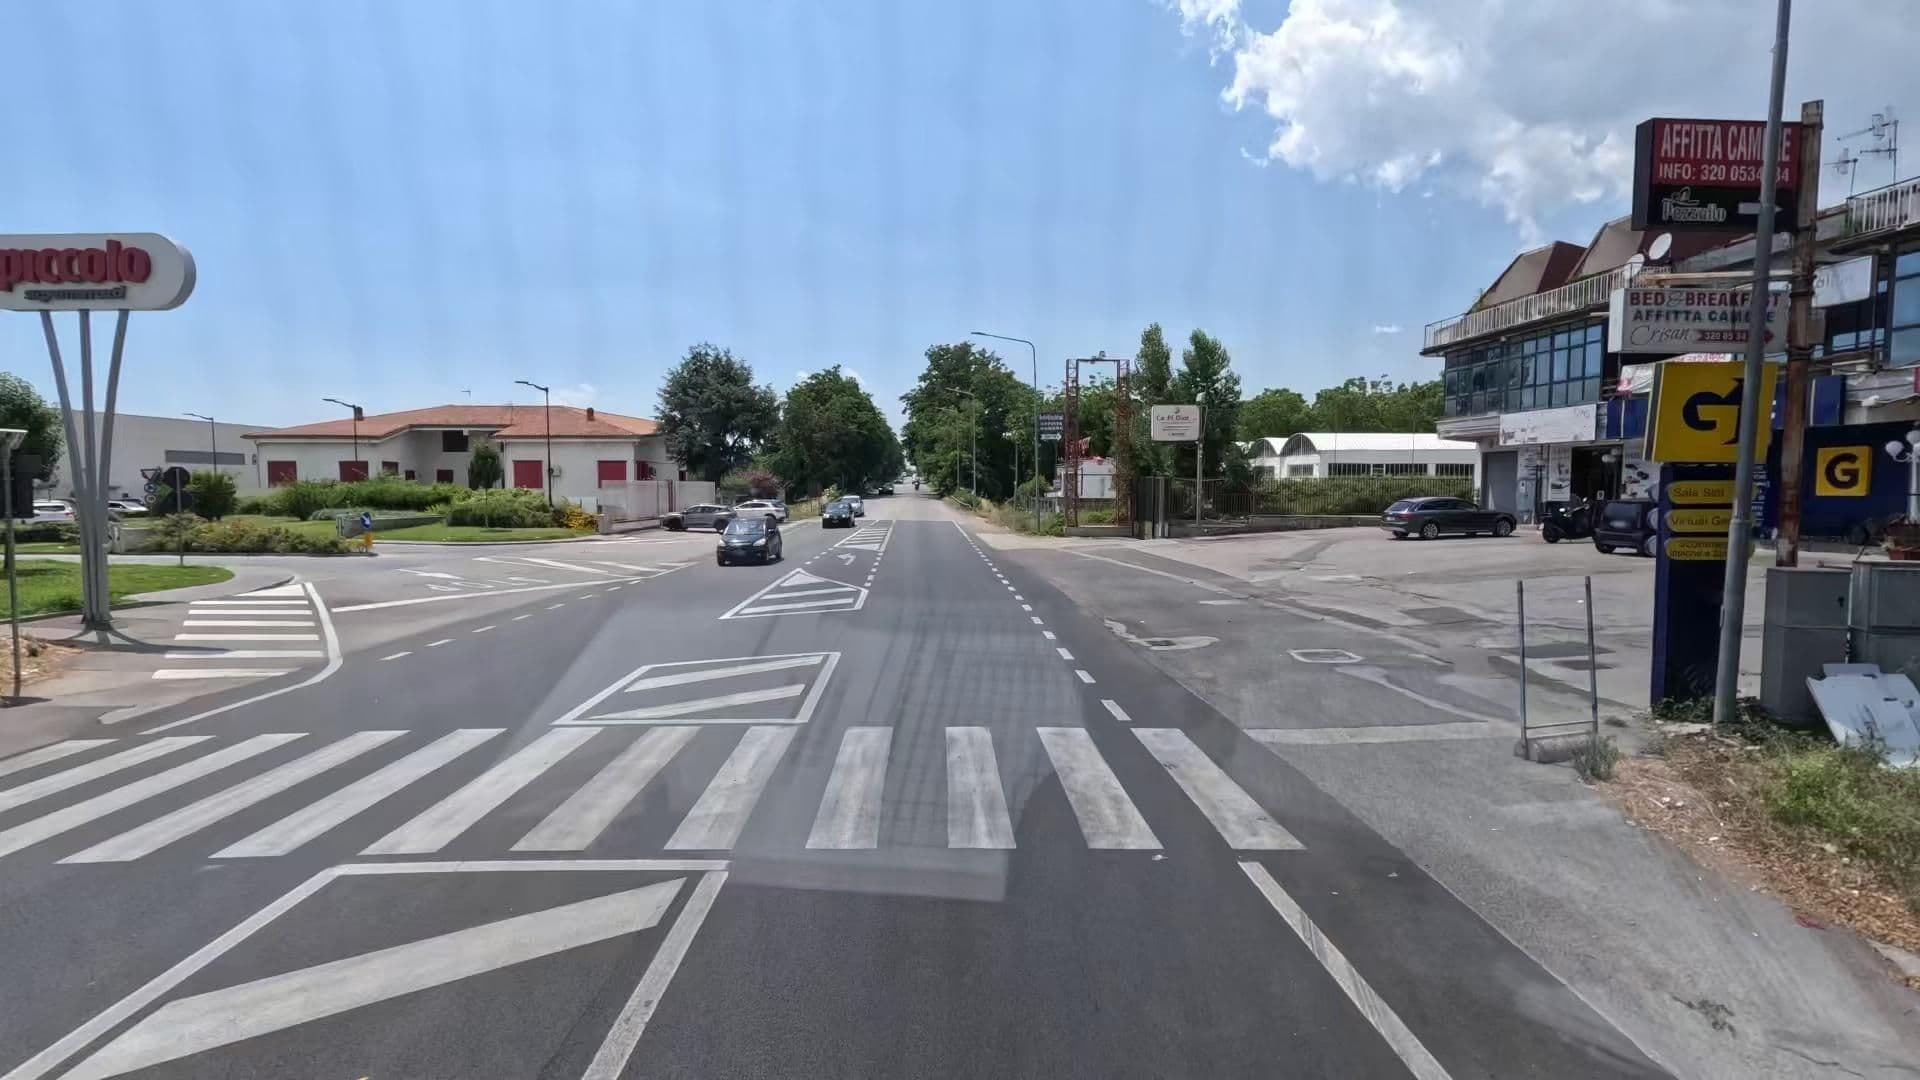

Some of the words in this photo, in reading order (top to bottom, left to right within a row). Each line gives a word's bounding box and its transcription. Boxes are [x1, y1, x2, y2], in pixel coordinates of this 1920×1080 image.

[1660, 123, 1722, 160] AFFITTA
[1727, 125, 1792, 162] CAME
[1659, 162, 1696, 180] INFO:
[1700, 164, 1726, 181] 320
[1630, 291, 1665, 306] BED
[1685, 292, 1781, 306] BREAKFT
[1632, 309, 1702, 322] AFFITTA
[1824, 452, 1860, 490] G
